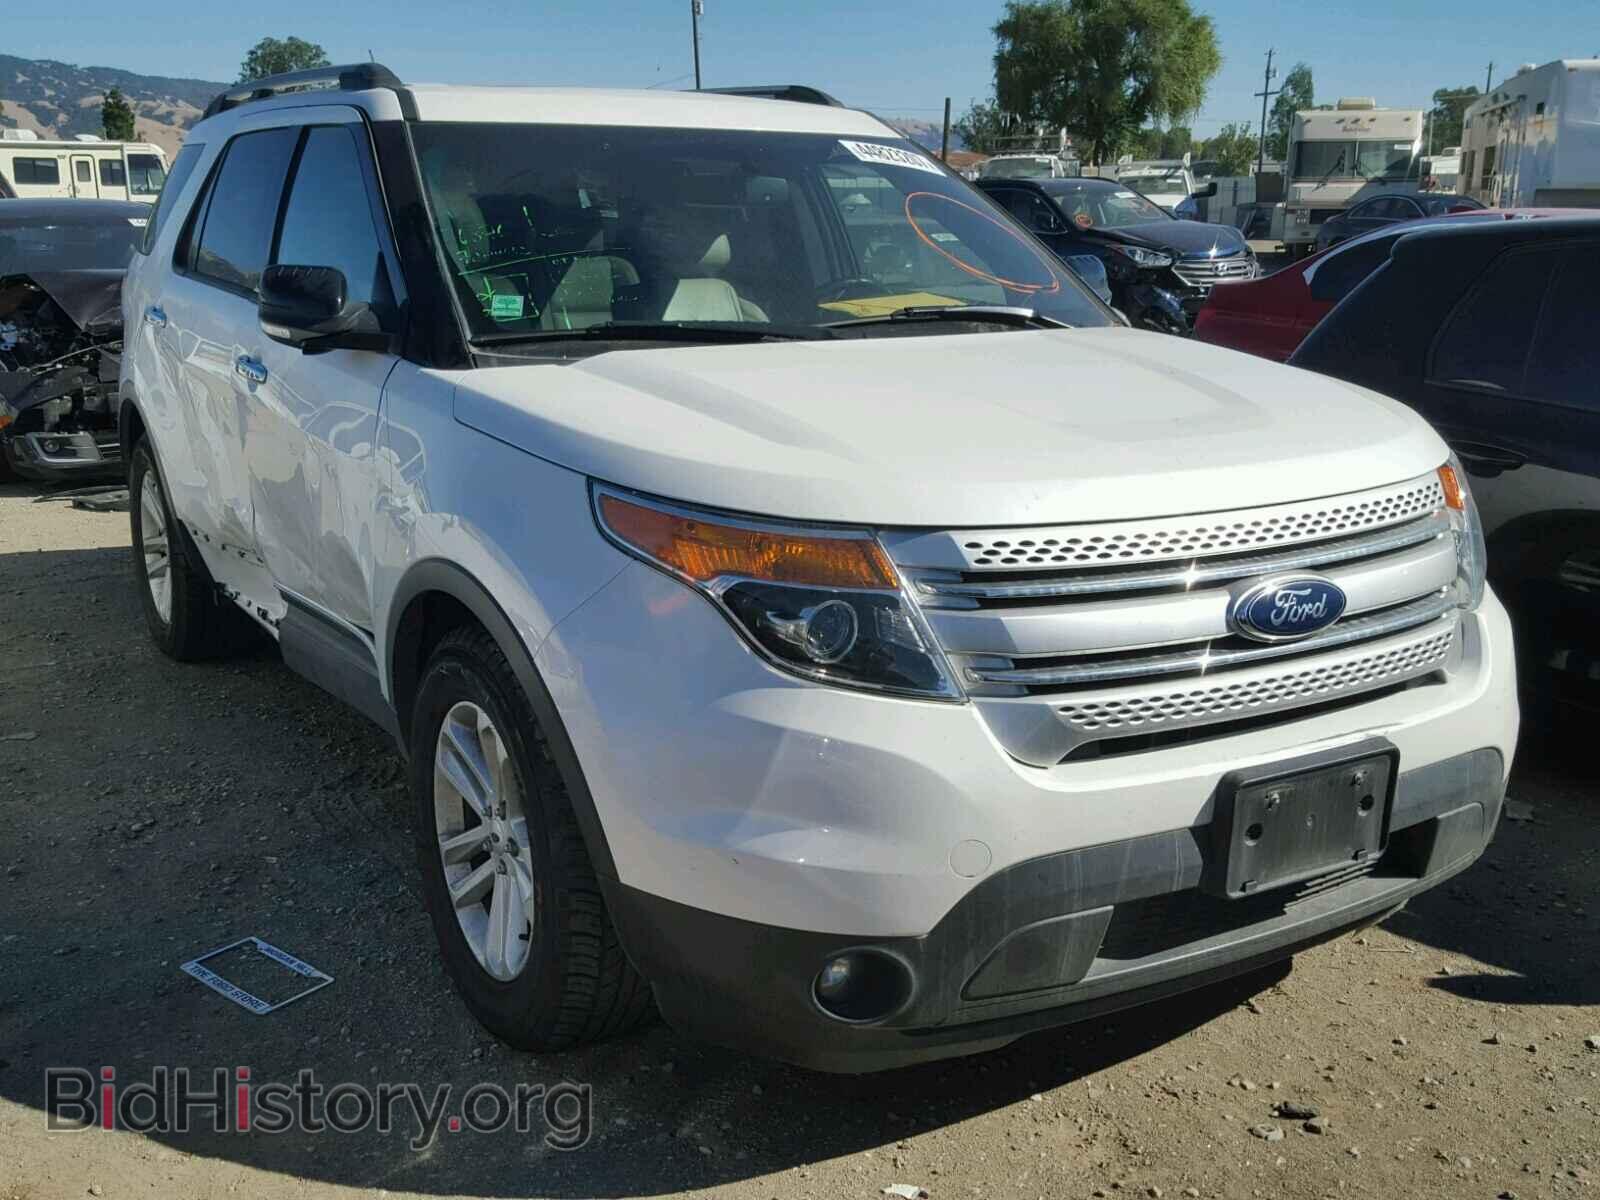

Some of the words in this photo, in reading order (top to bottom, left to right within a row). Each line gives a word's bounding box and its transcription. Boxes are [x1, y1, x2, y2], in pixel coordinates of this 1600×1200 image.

[1270, 588, 1328, 626] Ford
[207, 973, 235, 993] FORD
[231, 989, 265, 1010] STORE
